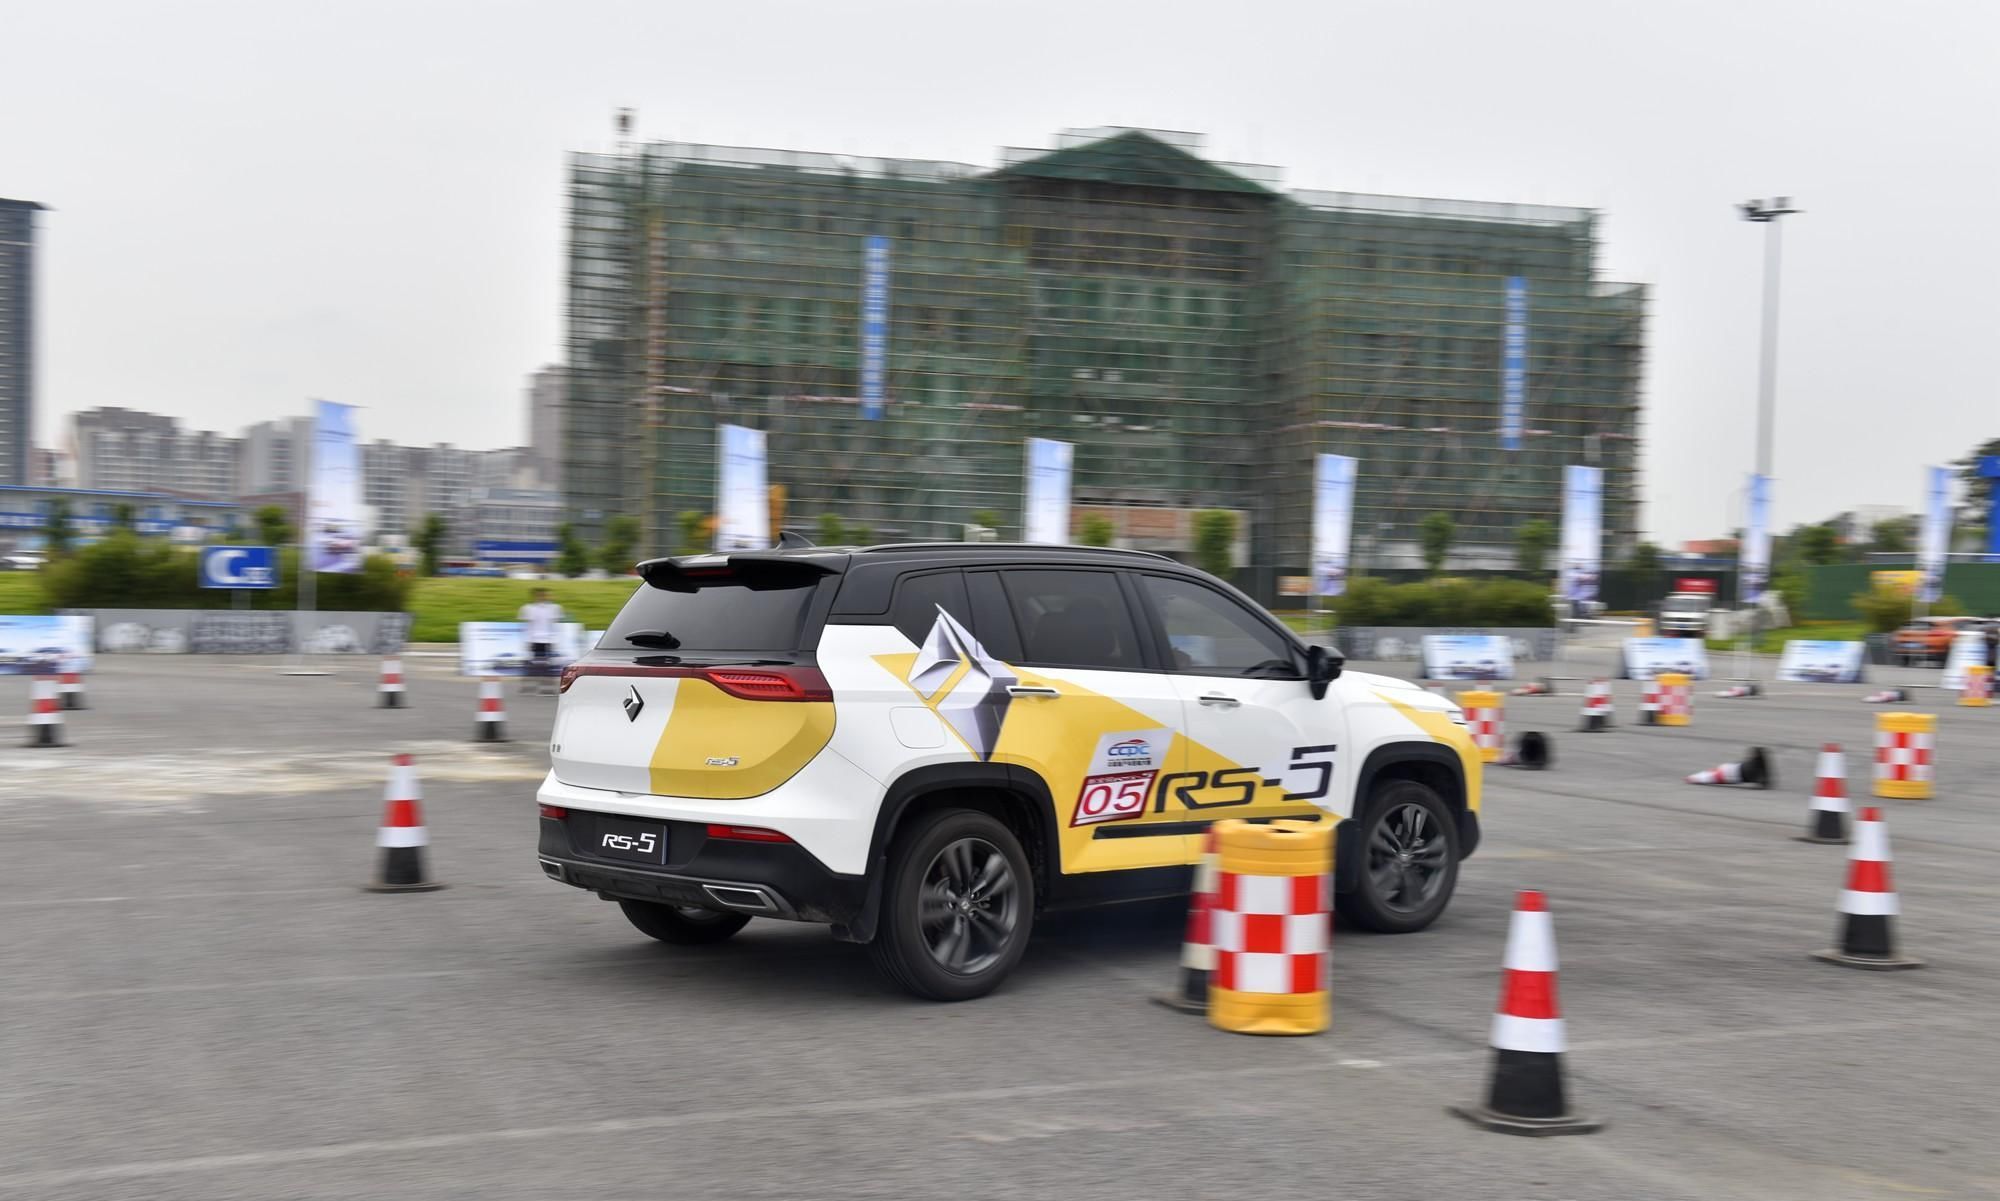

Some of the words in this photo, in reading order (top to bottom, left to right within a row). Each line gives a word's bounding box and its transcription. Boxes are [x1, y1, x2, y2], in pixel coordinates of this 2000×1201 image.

[1154, 744, 1337, 813] RS-5
[1083, 782, 1144, 815] 05
[602, 832, 657, 854] RS-5
